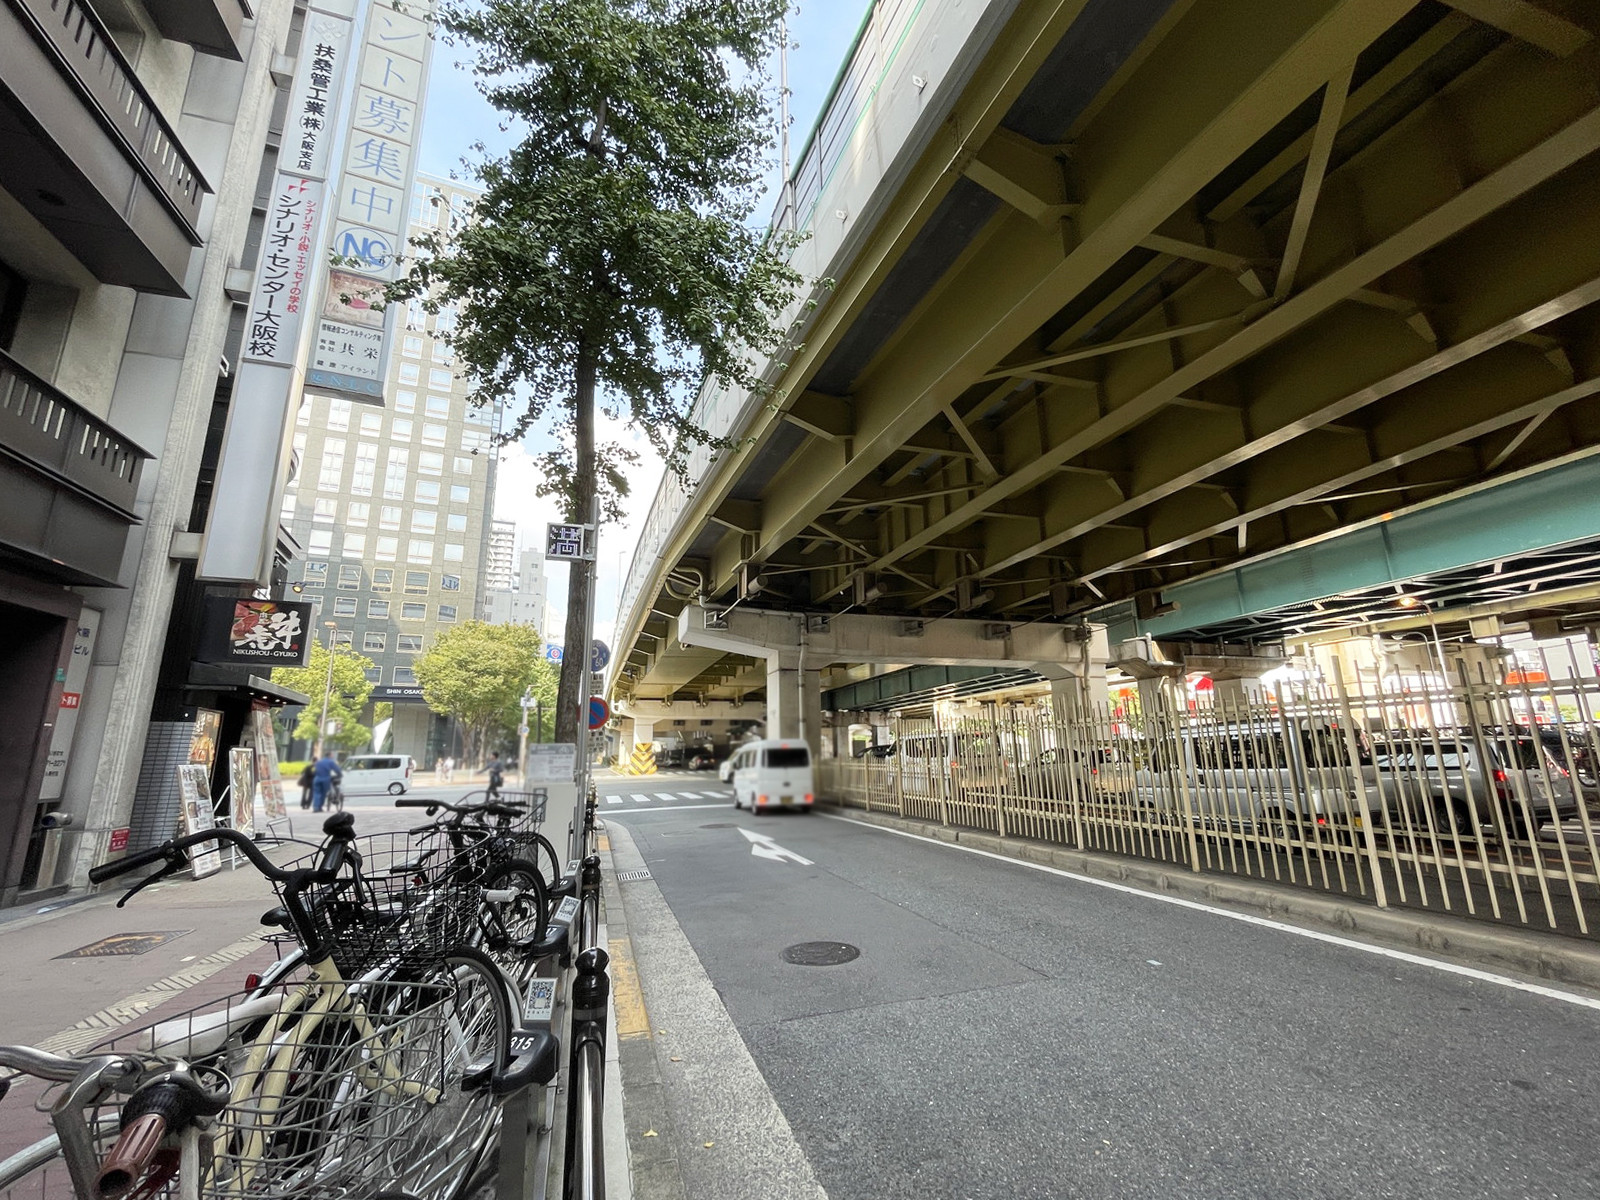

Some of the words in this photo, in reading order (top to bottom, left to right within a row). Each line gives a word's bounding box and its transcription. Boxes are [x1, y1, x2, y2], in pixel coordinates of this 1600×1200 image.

[248, 195, 301, 358] シナリオ・センター大阪校
